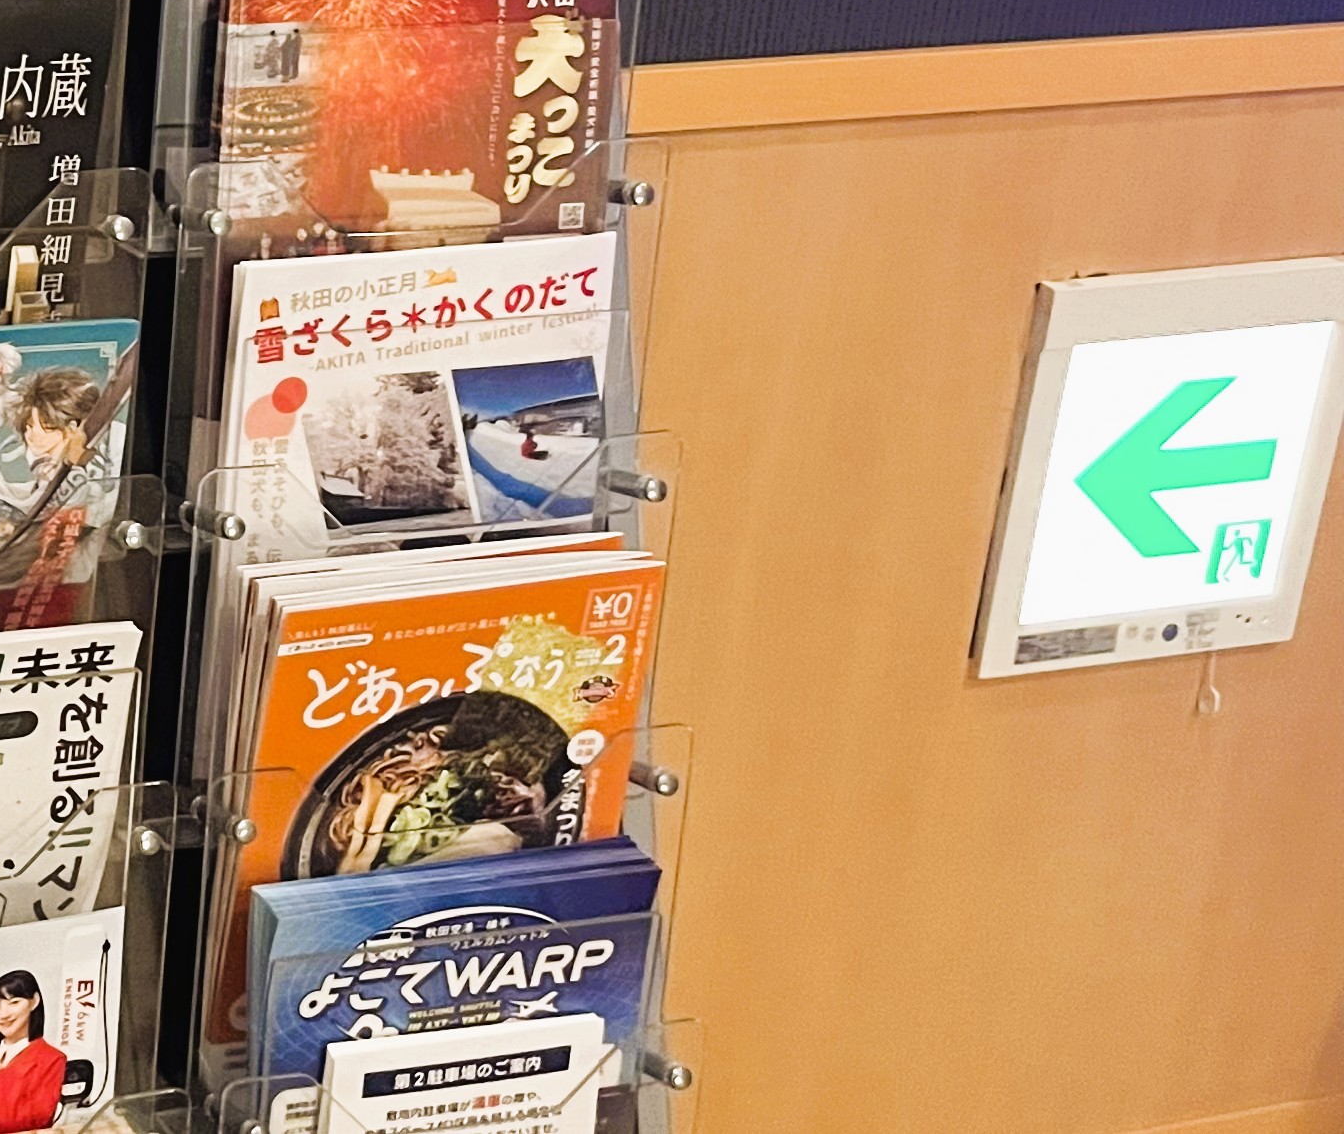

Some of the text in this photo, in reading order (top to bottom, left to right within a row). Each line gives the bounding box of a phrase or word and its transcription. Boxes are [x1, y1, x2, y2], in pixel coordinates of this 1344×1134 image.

[8, 124, 41, 147] Akita
[504, 112, 536, 204] まつり
[289, 270, 418, 313] 秋田の小正月
[374, 330, 472, 362] Traditional
[479, 321, 534, 342] winter
[592, 591, 633, 620] ¥0
[602, 634, 626, 666] 2
[302, 641, 566, 732] どあっぷなう
[393, 1055, 542, 1090] 第2駐車場のご案内
